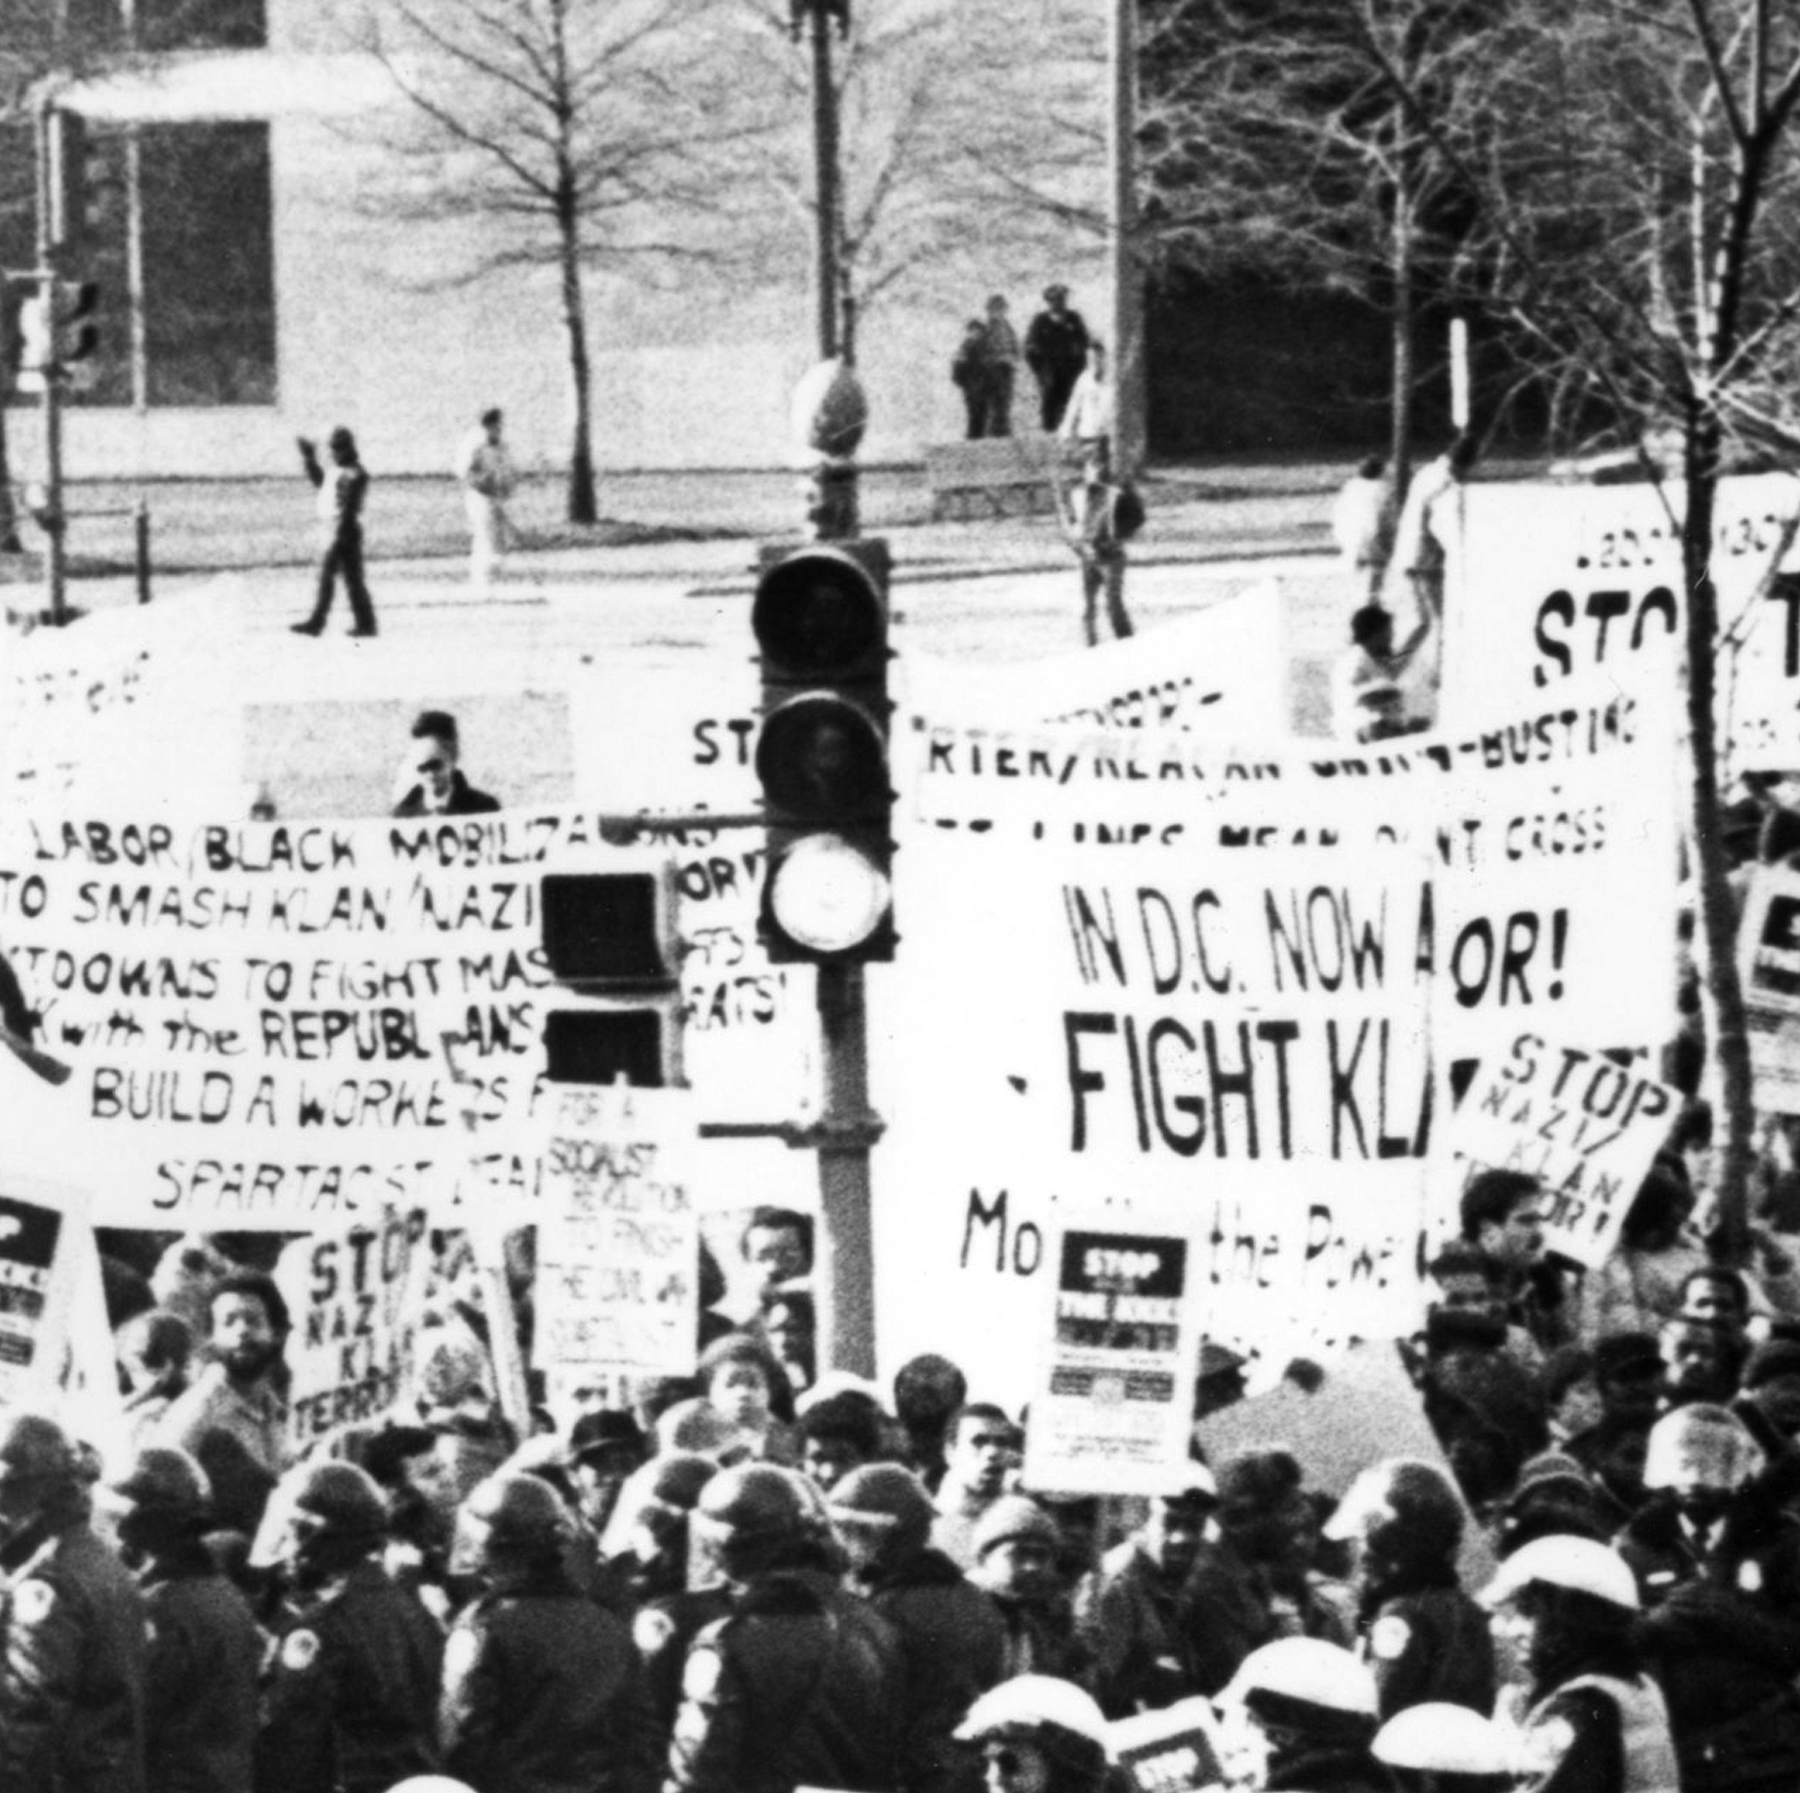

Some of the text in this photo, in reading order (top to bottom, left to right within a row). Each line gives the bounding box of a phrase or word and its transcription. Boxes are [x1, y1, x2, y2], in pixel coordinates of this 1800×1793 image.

[1533, 586, 1682, 688] STO
[692, 718, 753, 768] ST
[72, 881, 251, 930] SMASH
[1264, 884, 1388, 992] NOW
[245, 957, 294, 1002] TO
[310, 957, 442, 1001] FIGHT
[258, 1002, 534, 1061] REPUBLANS
[91, 1065, 234, 1125] BUILD
[246, 1073, 276, 1128] A
[1063, 1011, 1299, 1161] FIGHT
[1501, 1033, 1670, 1129] STOP
[310, 1206, 428, 1306] STOP
[1083, 1248, 1160, 1279] STOP
[305, 1294, 378, 1350] NAZ
